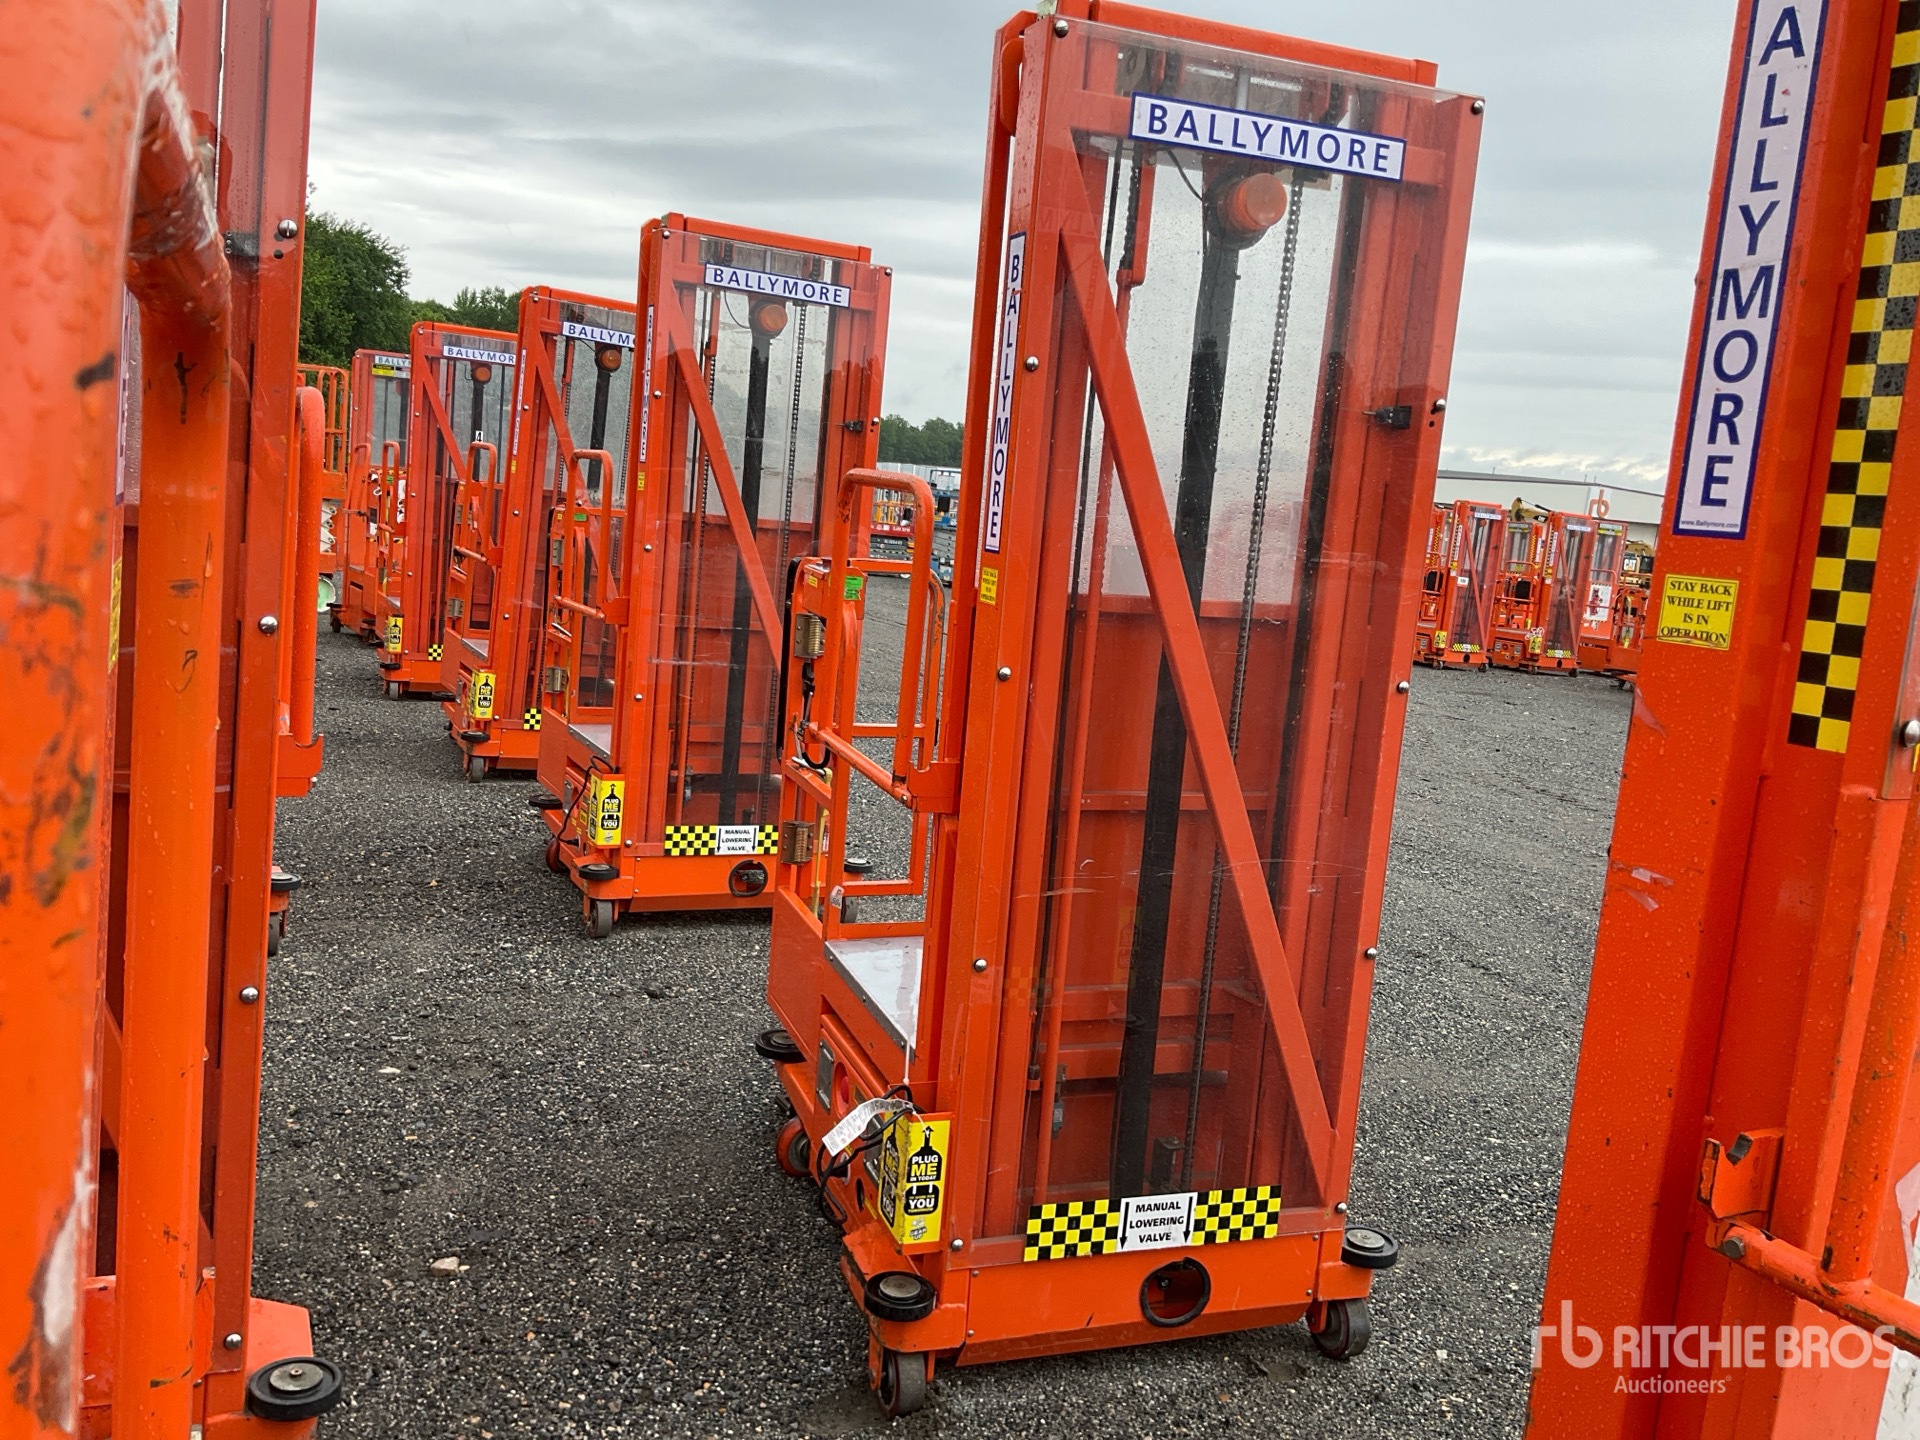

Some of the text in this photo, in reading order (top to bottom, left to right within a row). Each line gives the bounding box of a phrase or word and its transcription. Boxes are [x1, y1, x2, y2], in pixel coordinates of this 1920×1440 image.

[1147, 103, 1391, 173] BALLYMORE
[713, 268, 843, 304] BALLYMORE
[568, 324, 635, 346] BALLYM
[378, 356, 410, 366] BALLY
[990, 253, 1020, 539] BALLYMORE
[476, 431, 483, 442] 4
[1624, 559, 1637, 570] CAT
[1669, 580, 1732, 596] STAY BACK
[1666, 595, 1732, 612] WHILE LIFT
[1682, 612, 1710, 625] IS IN
[1660, 626, 1728, 644] OPERATION
[911, 1154, 939, 1164] PLUG
[910, 1163, 938, 1177] ME
[908, 1198, 935, 1209] YOU
[1135, 1201, 1182, 1213] MANUAL
[1129, 1216, 1185, 1229] LOWERING
[1138, 1232, 1172, 1243] VALVE
